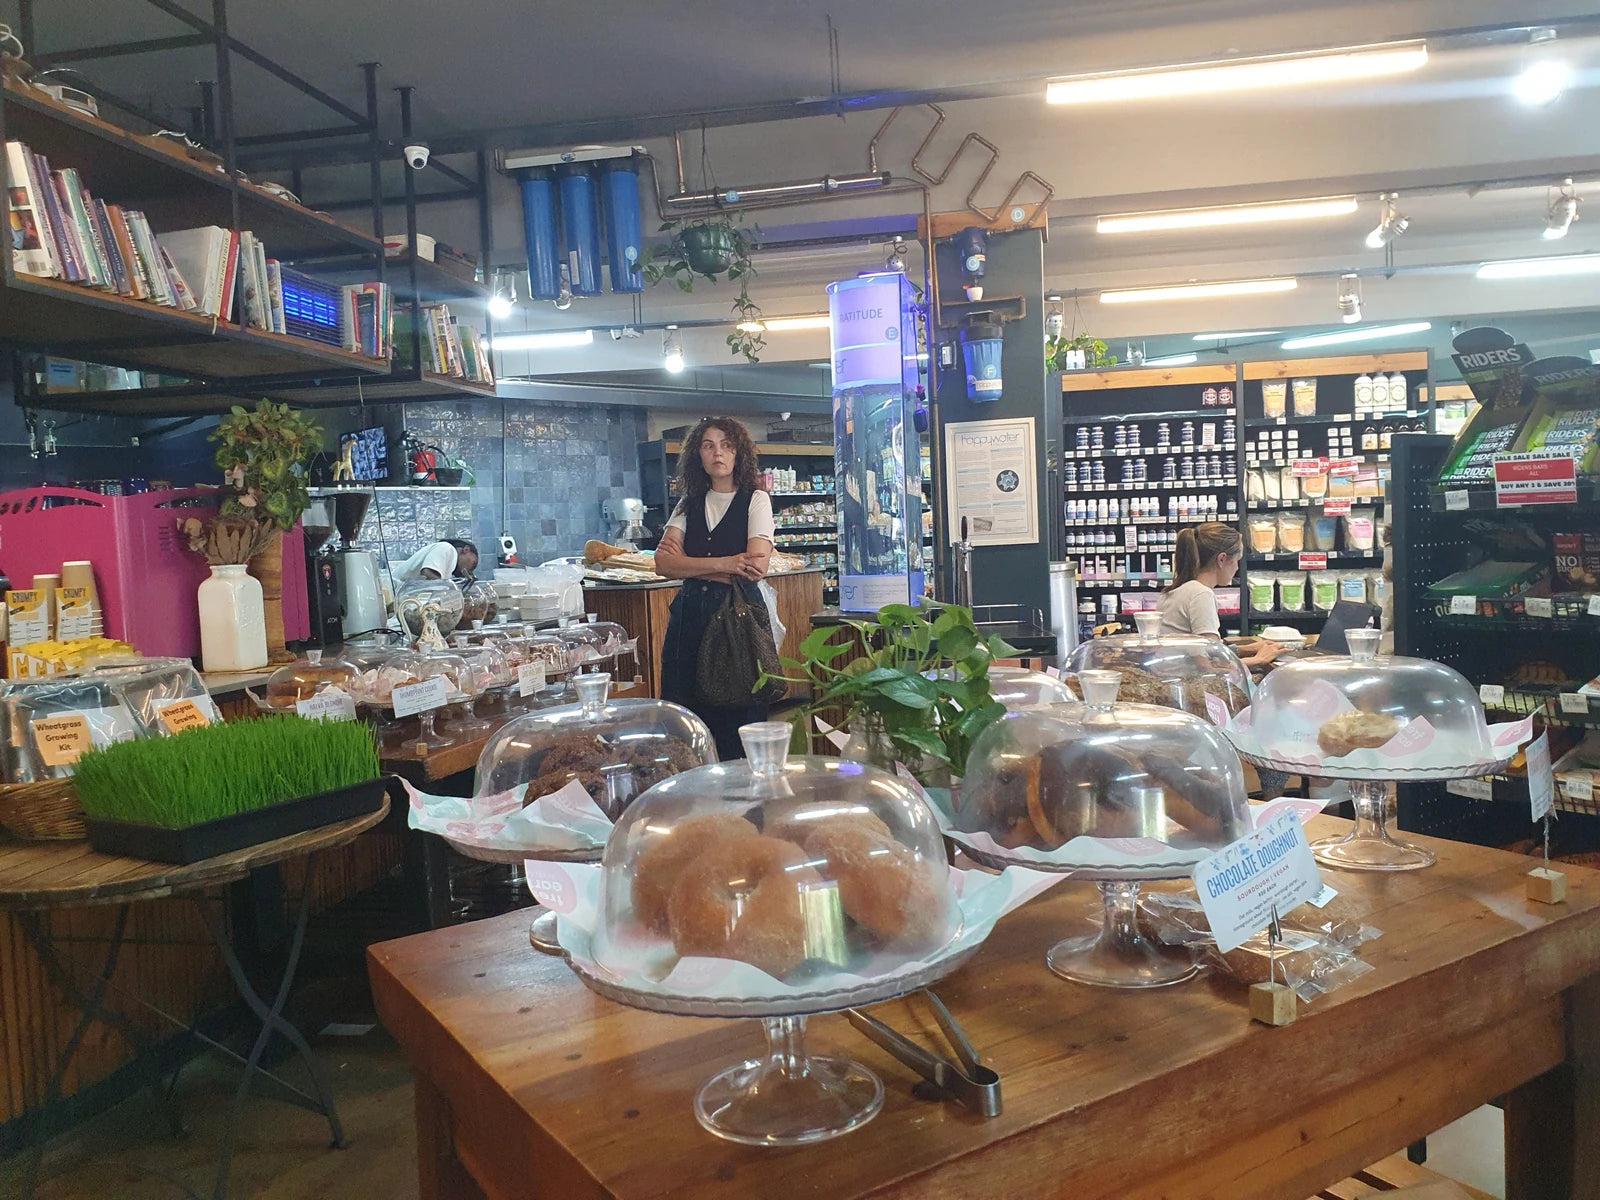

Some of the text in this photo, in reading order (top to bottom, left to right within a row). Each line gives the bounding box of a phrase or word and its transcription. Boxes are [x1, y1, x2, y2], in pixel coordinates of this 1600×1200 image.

[840, 308, 884, 322] RATITUDE
[1460, 348, 1521, 369] RIDERS
[1547, 428, 1589, 439] RIDERS
[1464, 467, 1494, 476] RIDER
[1555, 555, 1577, 567] NO
[12, 592, 38, 603] GRUMPY
[63, 587, 86, 599] GRUMPY
[161, 703, 195, 718] Wheatgrass
[173, 713, 198, 725] Growing
[35, 720, 82, 732] Wheatgrass
[45, 732, 79, 742] Growing
[59, 743, 72, 751] Kit
[1206, 853, 1259, 899] CHOCOLATE
[1258, 827, 1299, 868] DOUGHNUT
[1237, 877, 1270, 901] SOURDOUGH
[1274, 864, 1289, 878] VEGAN
